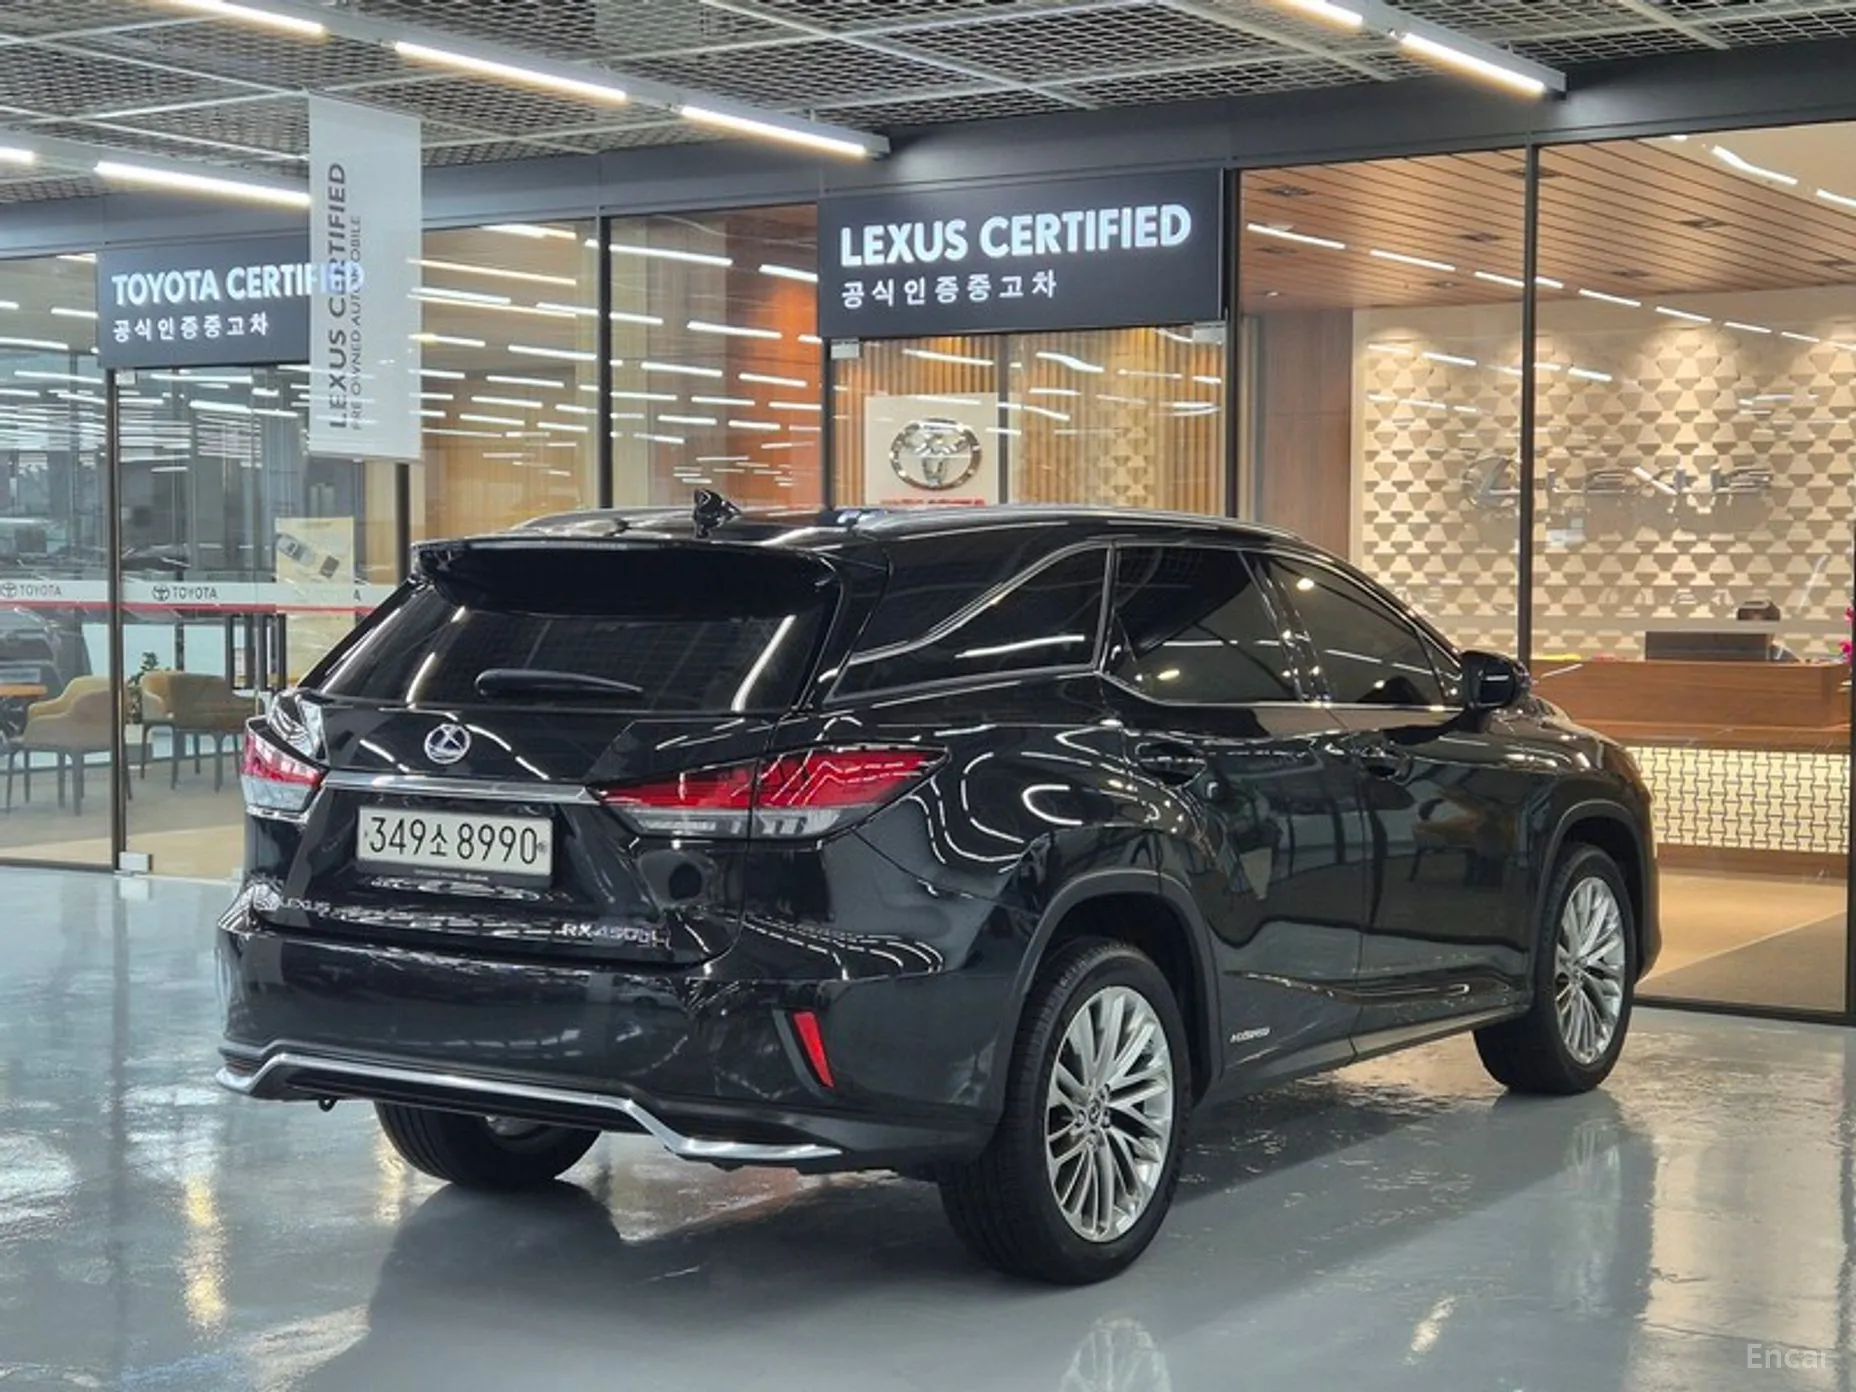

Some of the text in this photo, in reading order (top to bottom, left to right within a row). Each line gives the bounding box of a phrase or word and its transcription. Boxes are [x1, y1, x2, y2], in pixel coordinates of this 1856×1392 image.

[839, 203, 1193, 268] LEXUS CERTIFIED
[111, 267, 220, 306] TOYOTA
[328, 329, 347, 428] LEXUS
[19, 583, 62, 598] TOYOTA
[172, 585, 220, 600] TOYOTA
